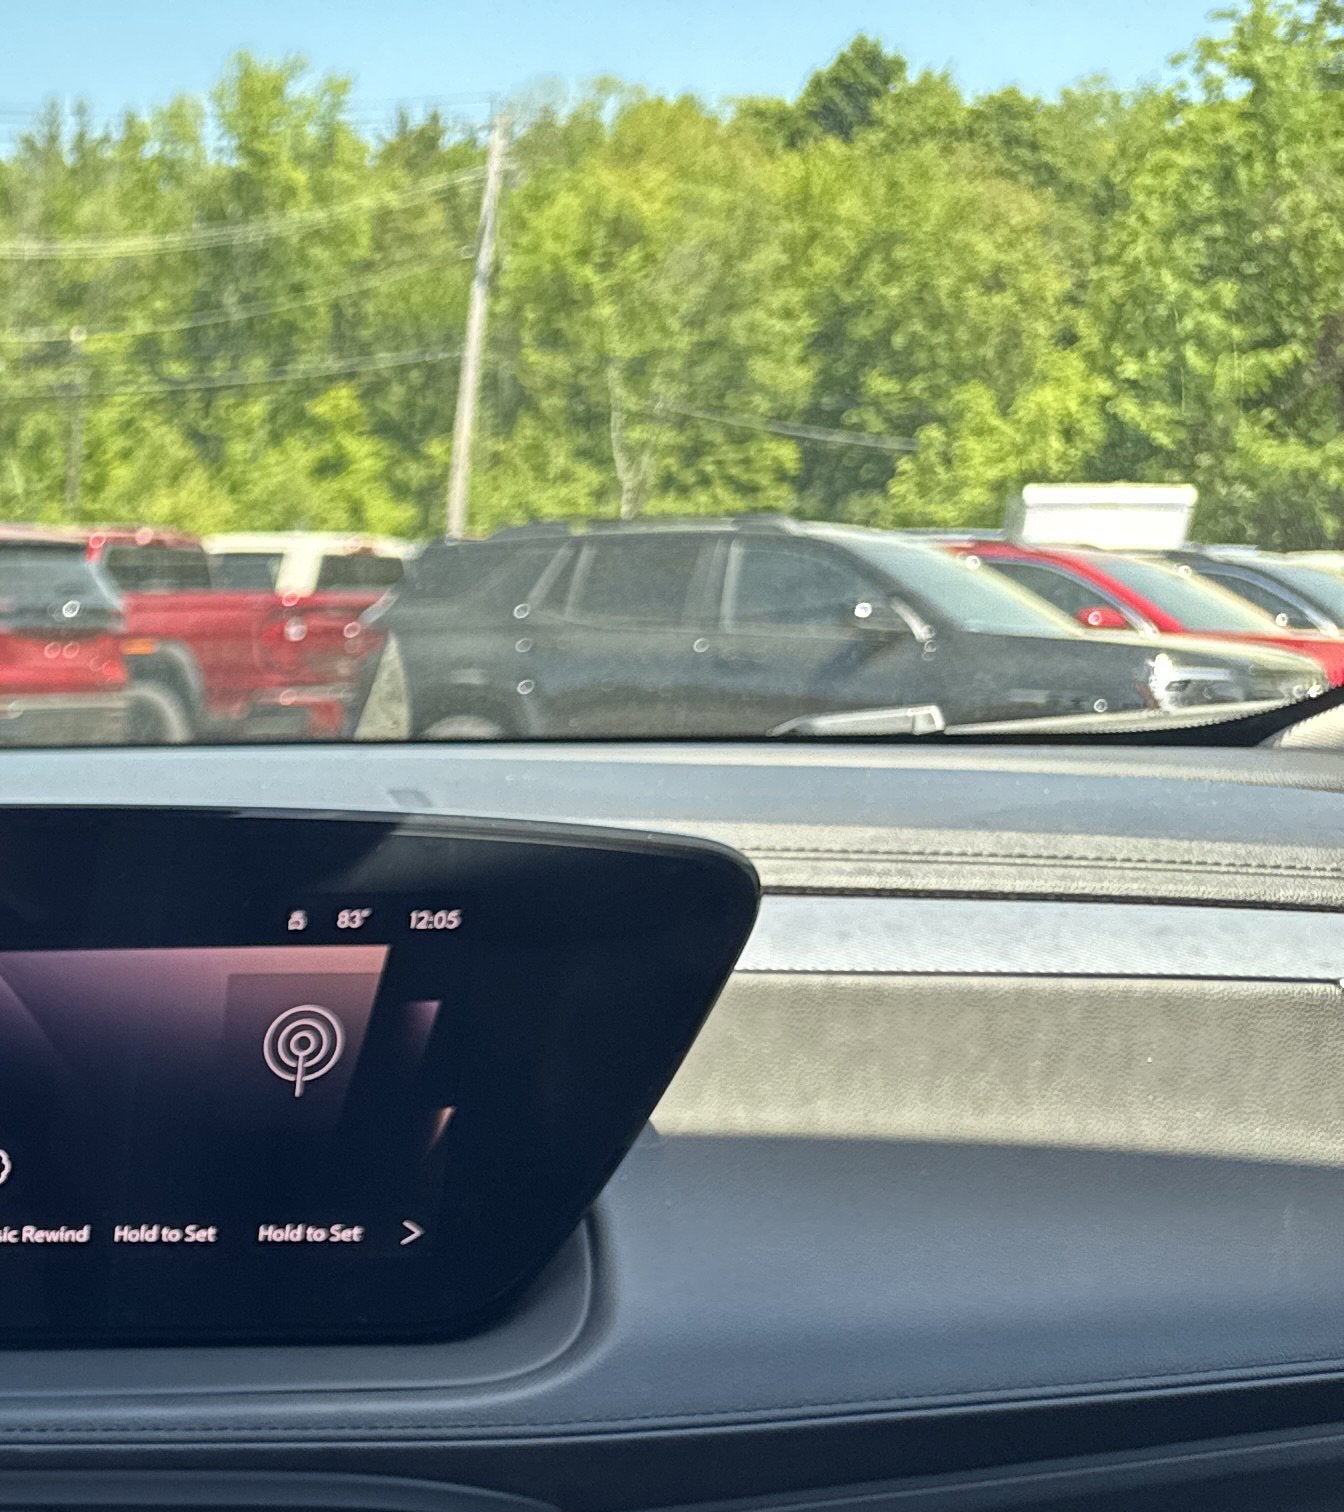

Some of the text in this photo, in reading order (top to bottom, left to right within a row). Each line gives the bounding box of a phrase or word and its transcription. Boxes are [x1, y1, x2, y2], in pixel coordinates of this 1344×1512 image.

[410, 909, 462, 930] 12:05
[22, 1225, 91, 1244] Rewind
[114, 1224, 217, 1243] Hold to Set
[259, 1224, 363, 1242] Hold to Set
